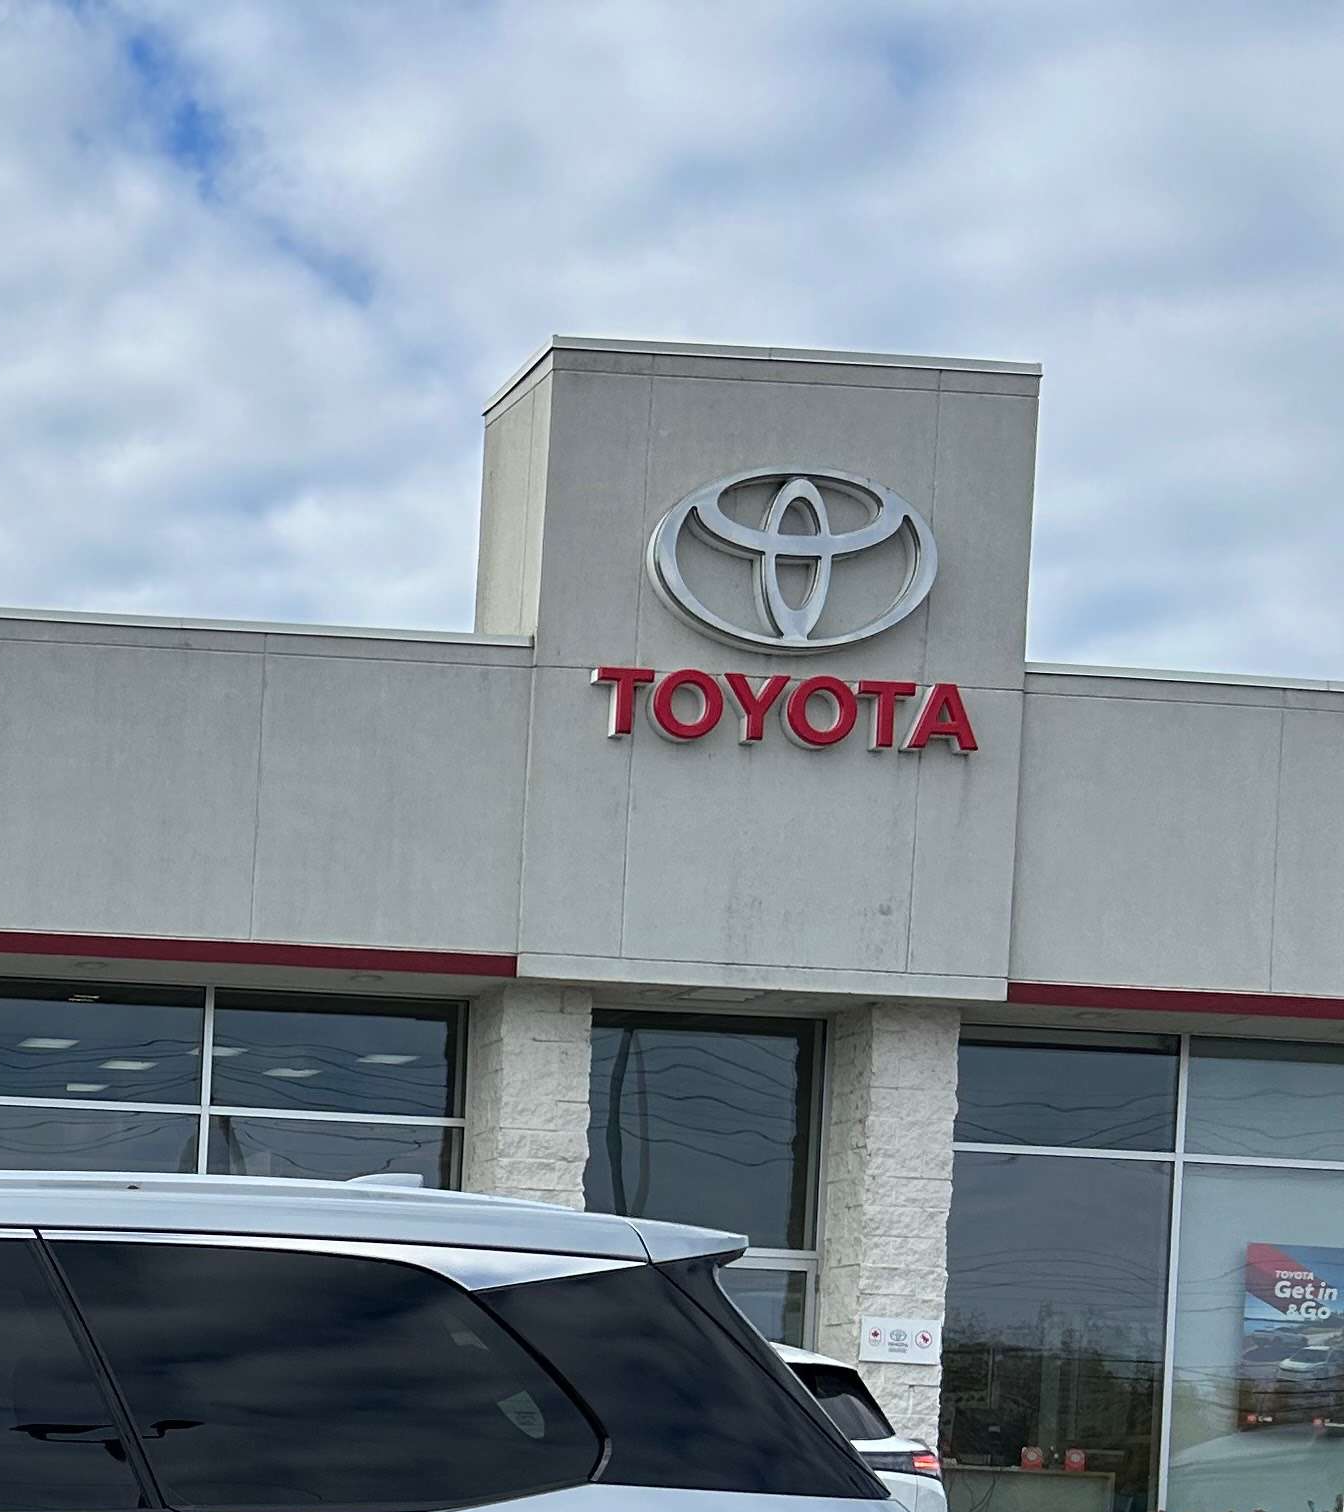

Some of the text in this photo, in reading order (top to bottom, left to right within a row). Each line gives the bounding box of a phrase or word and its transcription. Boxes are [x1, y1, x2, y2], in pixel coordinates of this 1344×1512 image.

[591, 666, 978, 755] TOYOTA
[1275, 1270, 1314, 1280] TOYOTA
[1274, 1281, 1339, 1301] Get in
